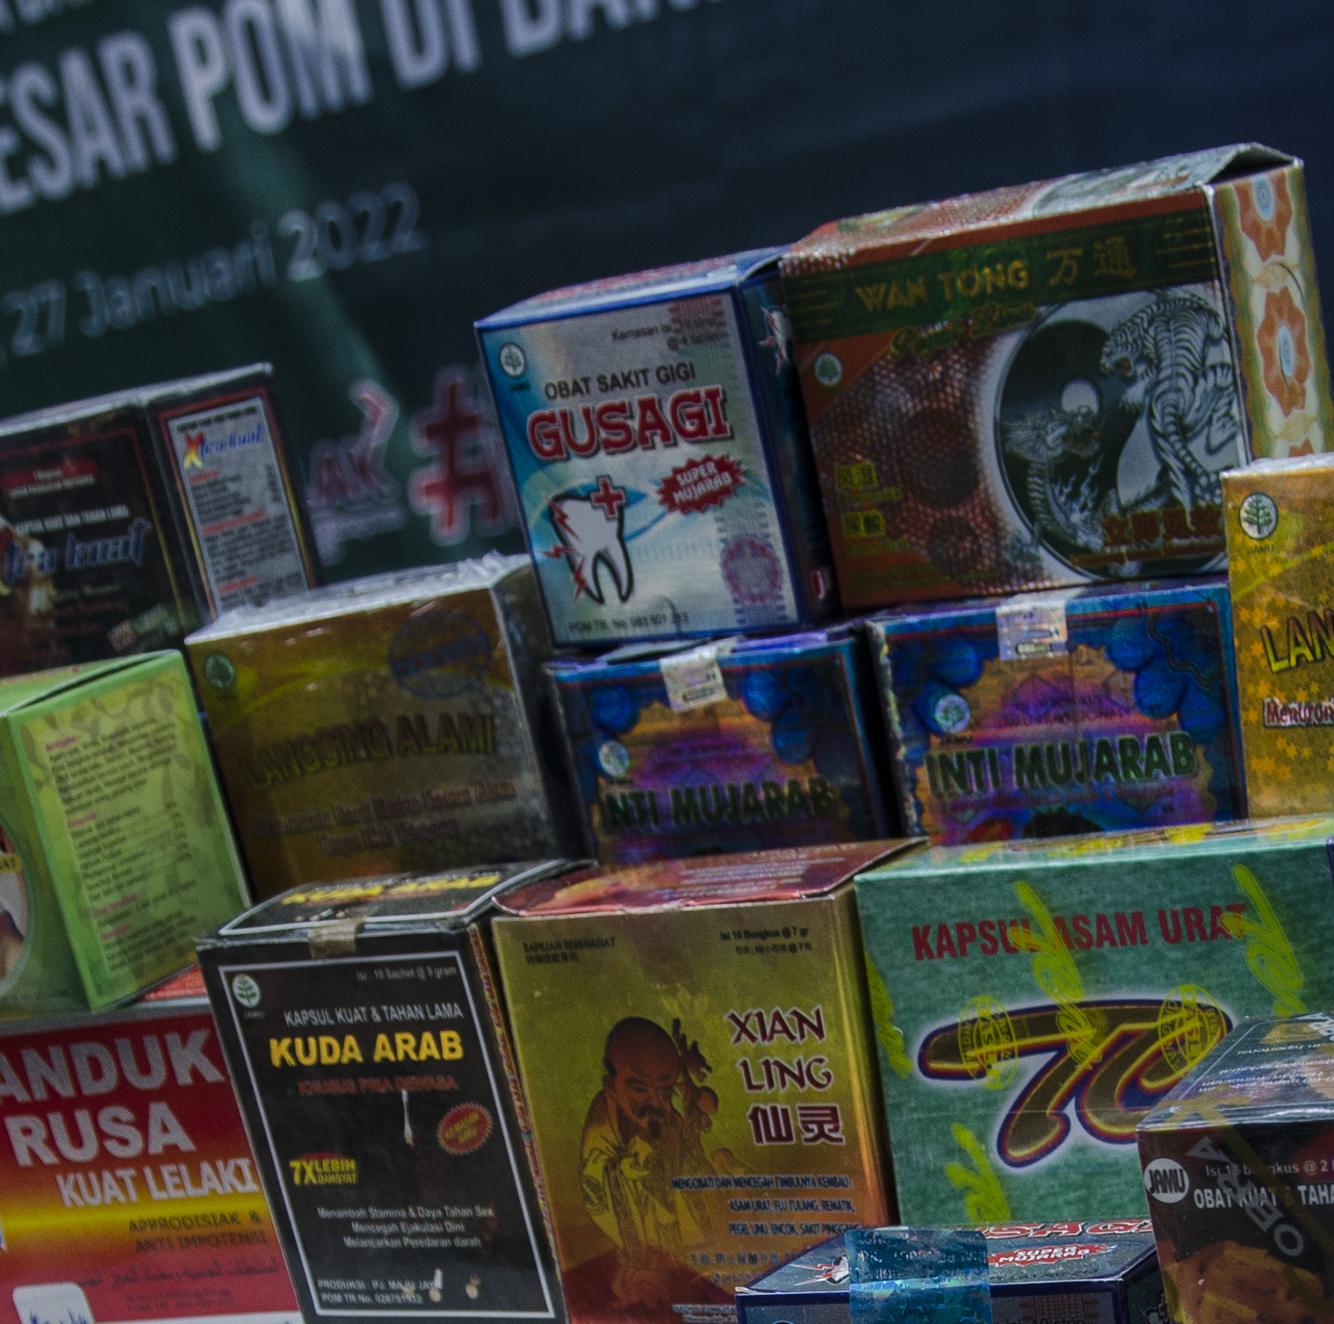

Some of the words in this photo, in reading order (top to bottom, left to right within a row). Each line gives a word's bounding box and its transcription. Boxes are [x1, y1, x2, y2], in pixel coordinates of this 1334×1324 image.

[167, 0, 373, 150] POM
[375, 0, 483, 92] DI
[0, 280, 69, 358] 27
[71, 218, 281, 335] Januari
[277, 182, 431, 282] 2022
[545, 376, 592, 401] OBAT
[597, 369, 650, 394] SAKIT
[655, 361, 697, 389] GIGI
[527, 384, 735, 461] GUSAGI
[924, 746, 1002, 800] INTI
[1012, 730, 1199, 790] MUJARAB
[597, 783, 660, 834] INTI
[671, 773, 834, 828] MUJARAB
[912, 918, 1040, 962] KAPSUL
[1050, 909, 1150, 951] ASAM
[1157, 902, 1251, 945] URAT
[283, 1007, 331, 1027] KAPSUL
[333, 1005, 369, 1025] KUAT
[370, 1005, 381, 1024] &
[382, 1003, 426, 1023] TAHAN
[426, 1001, 465, 1021] LAMA
[724, 1004, 828, 1047] XIAN
[269, 1033, 364, 1069] KUDA
[373, 1029, 465, 1063] ARAB
[735, 1054, 835, 1094] LING
[3, 1100, 197, 1168] RUSA
[55, 1170, 146, 1210] KUAT
[148, 1156, 261, 1201] LELAKI
[1146, 1167, 1187, 1196] JAMU
[1193, 1187, 1233, 1209] OBAT
